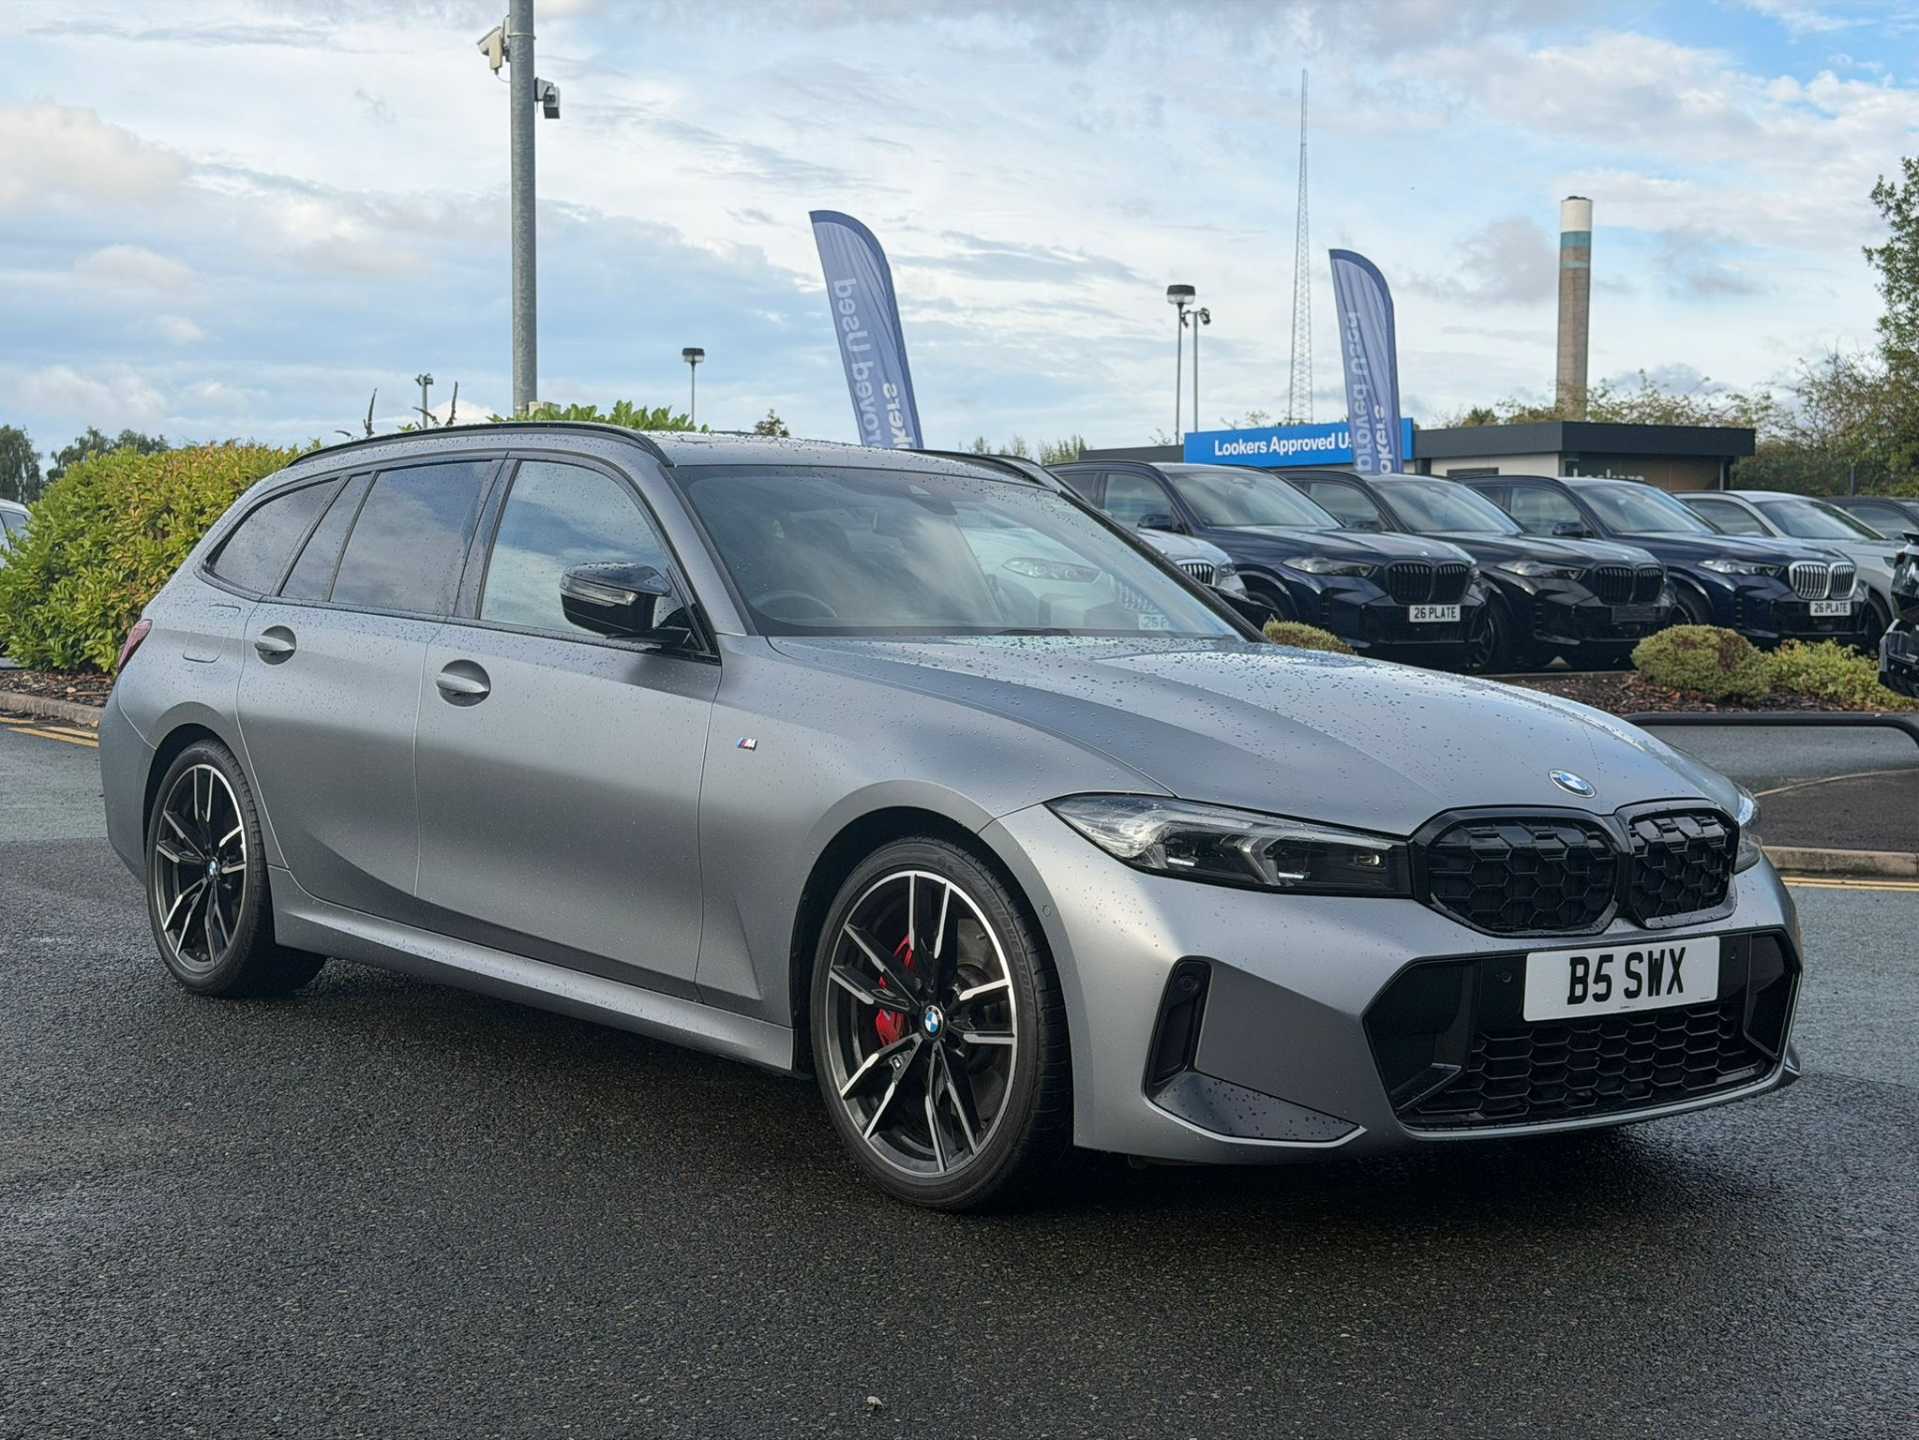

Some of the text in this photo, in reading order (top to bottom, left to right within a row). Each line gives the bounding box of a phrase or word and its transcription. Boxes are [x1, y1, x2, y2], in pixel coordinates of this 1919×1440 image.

[1214, 431, 1352, 457] Lookers Approved U
[1414, 606, 1457, 619] 26 PLATE
[1567, 947, 1687, 1005] B5 SWX
